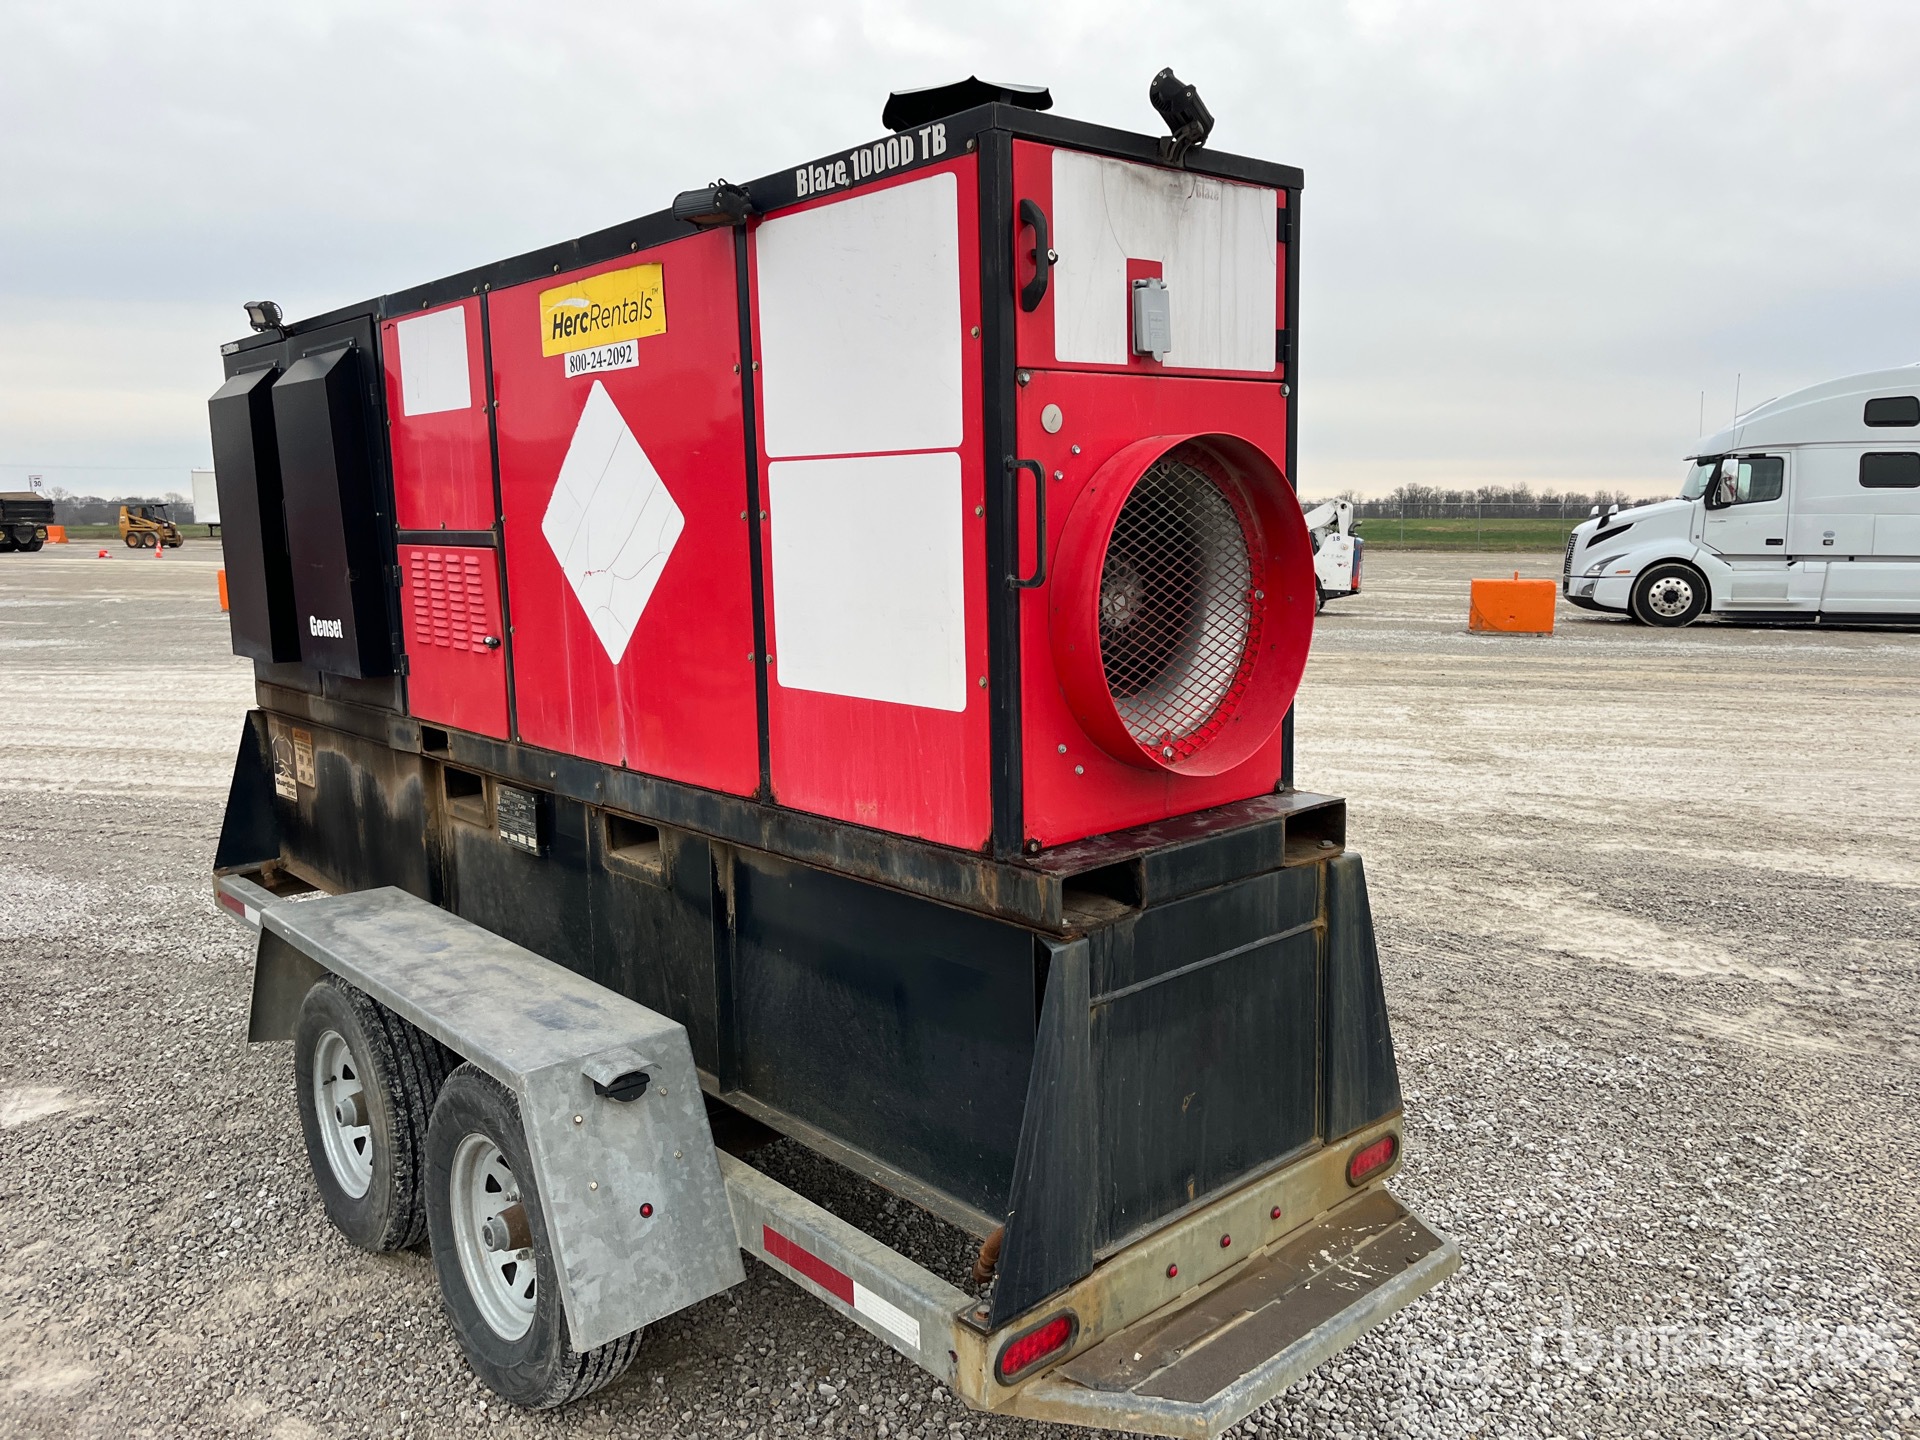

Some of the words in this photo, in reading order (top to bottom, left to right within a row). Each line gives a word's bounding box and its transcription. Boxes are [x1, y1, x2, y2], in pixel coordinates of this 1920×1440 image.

[796, 159, 847, 198] Blaze
[850, 135, 915, 181] 1000D
[918, 122, 947, 160] TB
[569, 344, 633, 374] 800-24-2092
[309, 615, 344, 639] Genset
